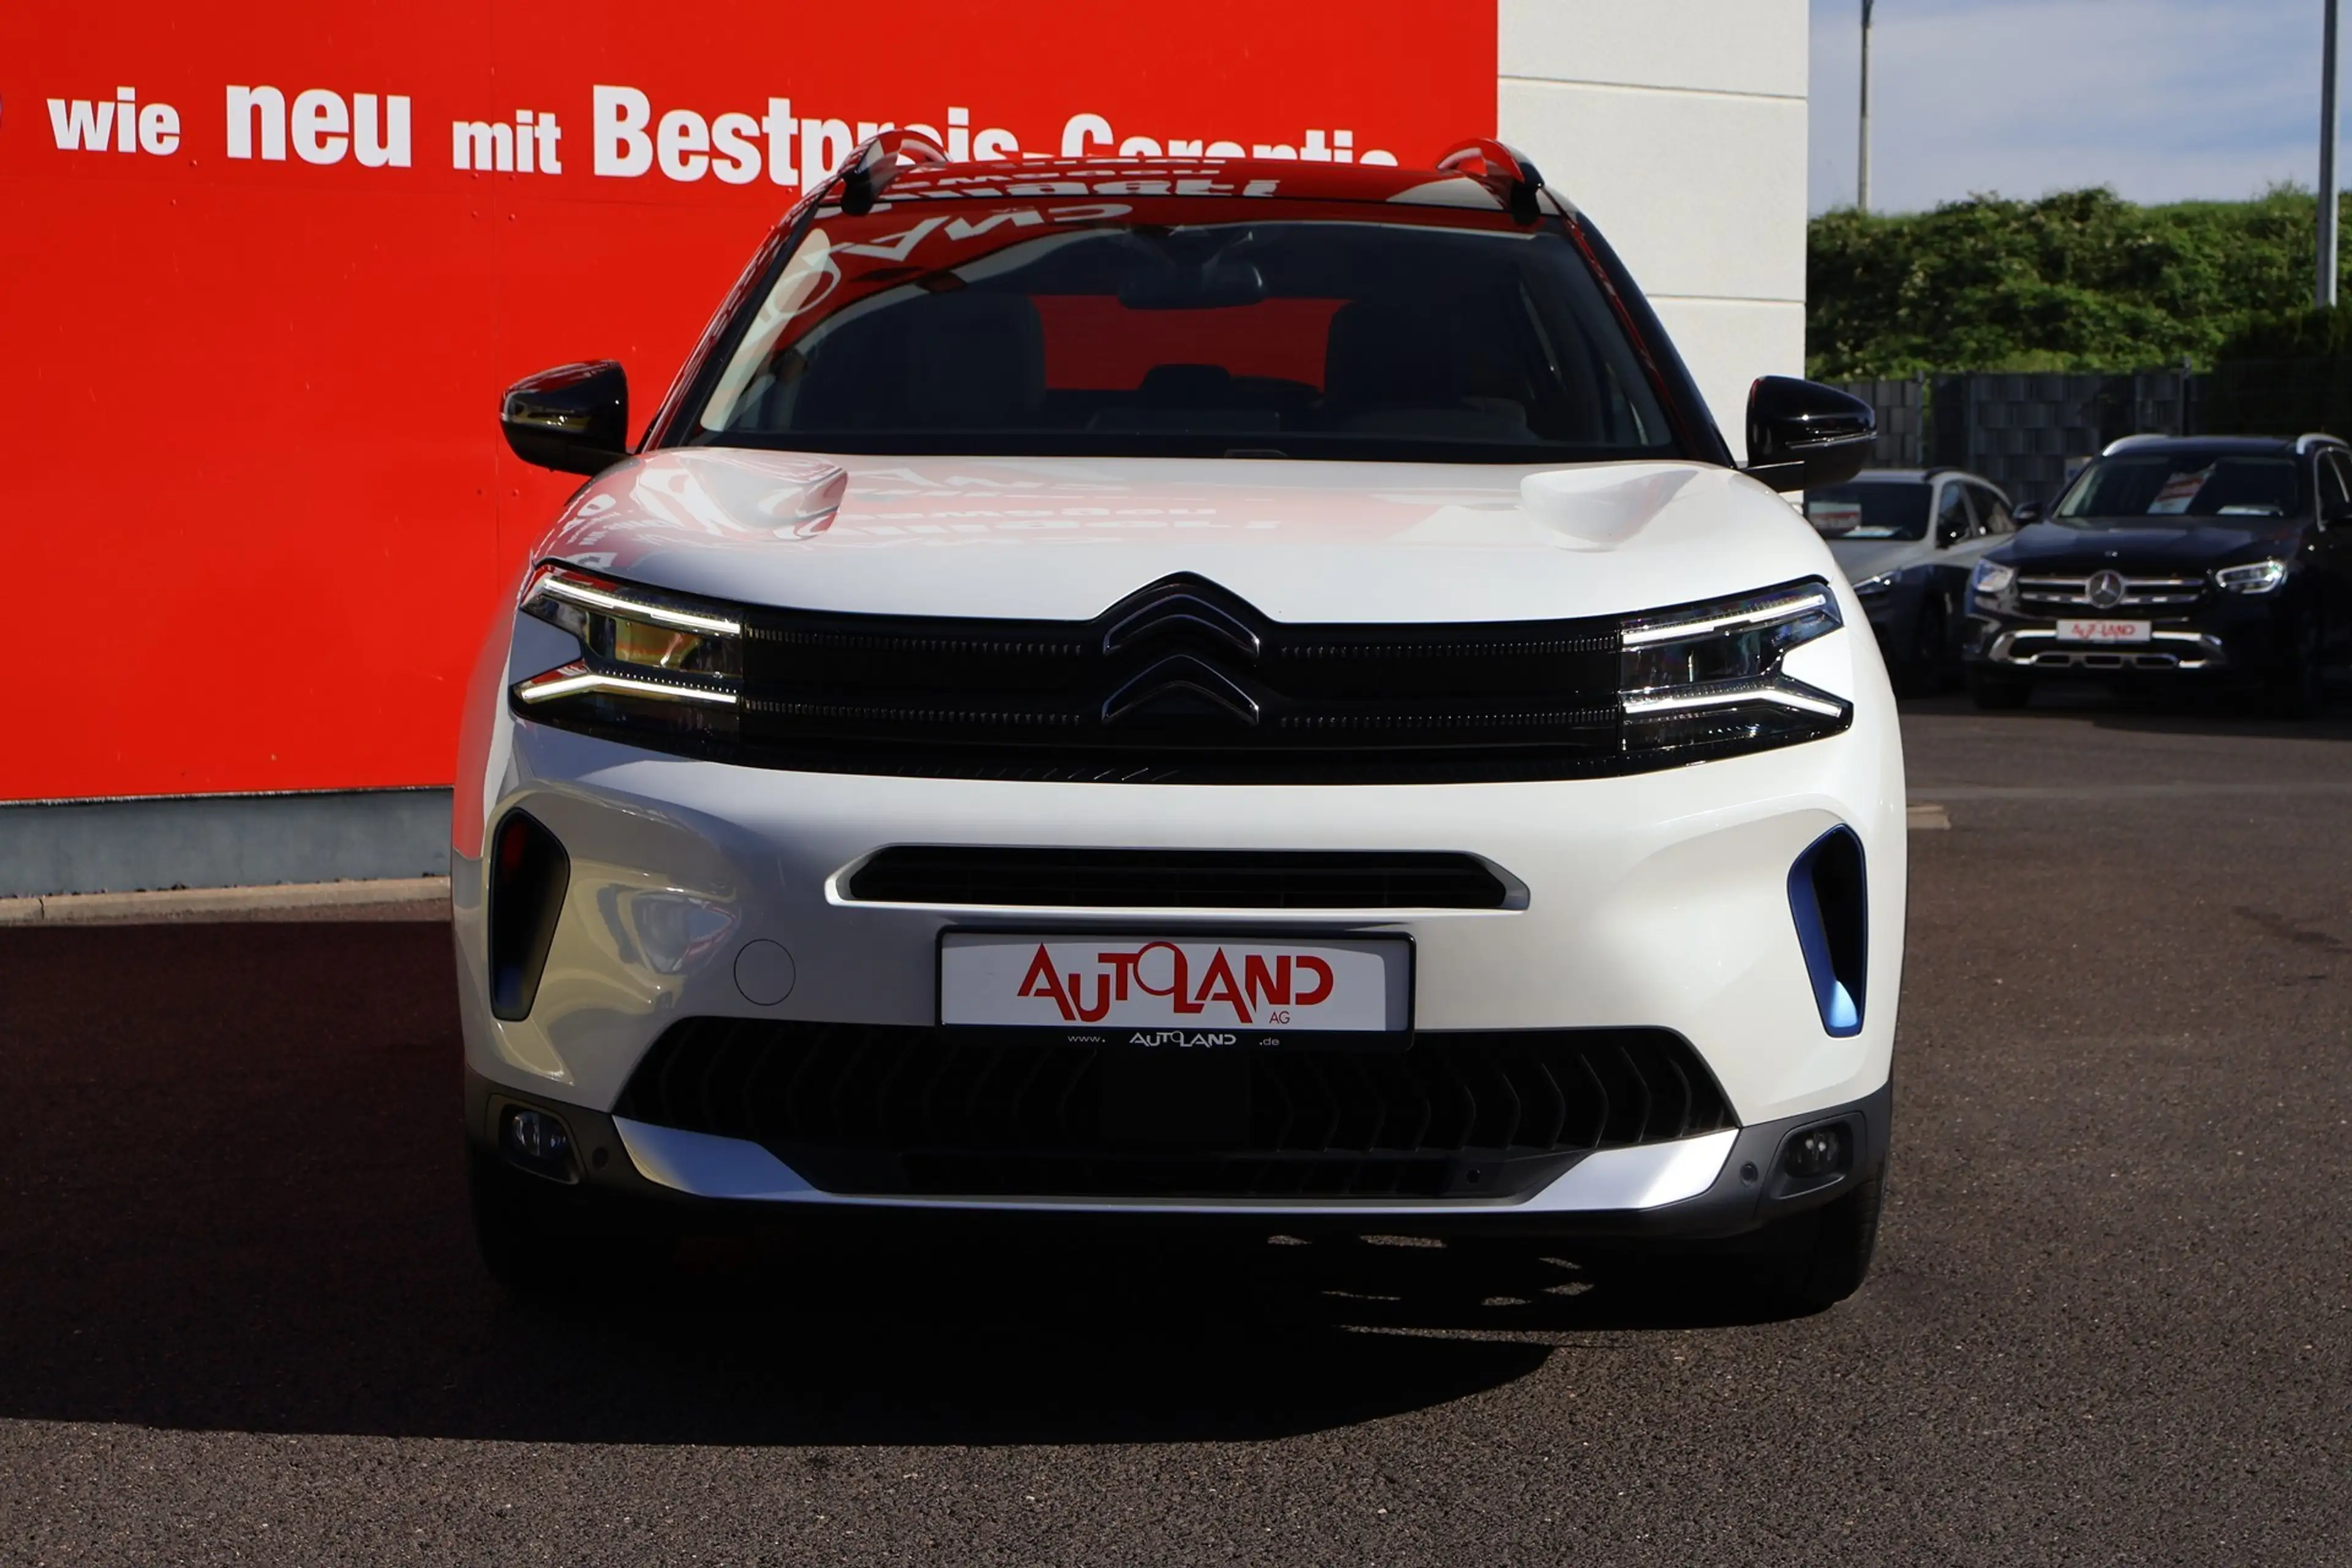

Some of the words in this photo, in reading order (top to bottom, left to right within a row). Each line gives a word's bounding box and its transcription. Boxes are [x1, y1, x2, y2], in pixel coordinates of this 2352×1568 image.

[47, 86, 180, 156] wie
[226, 85, 412, 167] neu
[453, 109, 562, 175] mit
[1017, 941, 1334, 1023] AUTOLAND
[1067, 1035, 1106, 1043] www.
[1129, 1030, 1237, 1048] AUTOLAND
[1259, 1037, 1281, 1046] .de
[1268, 1011, 1291, 1025] AG
